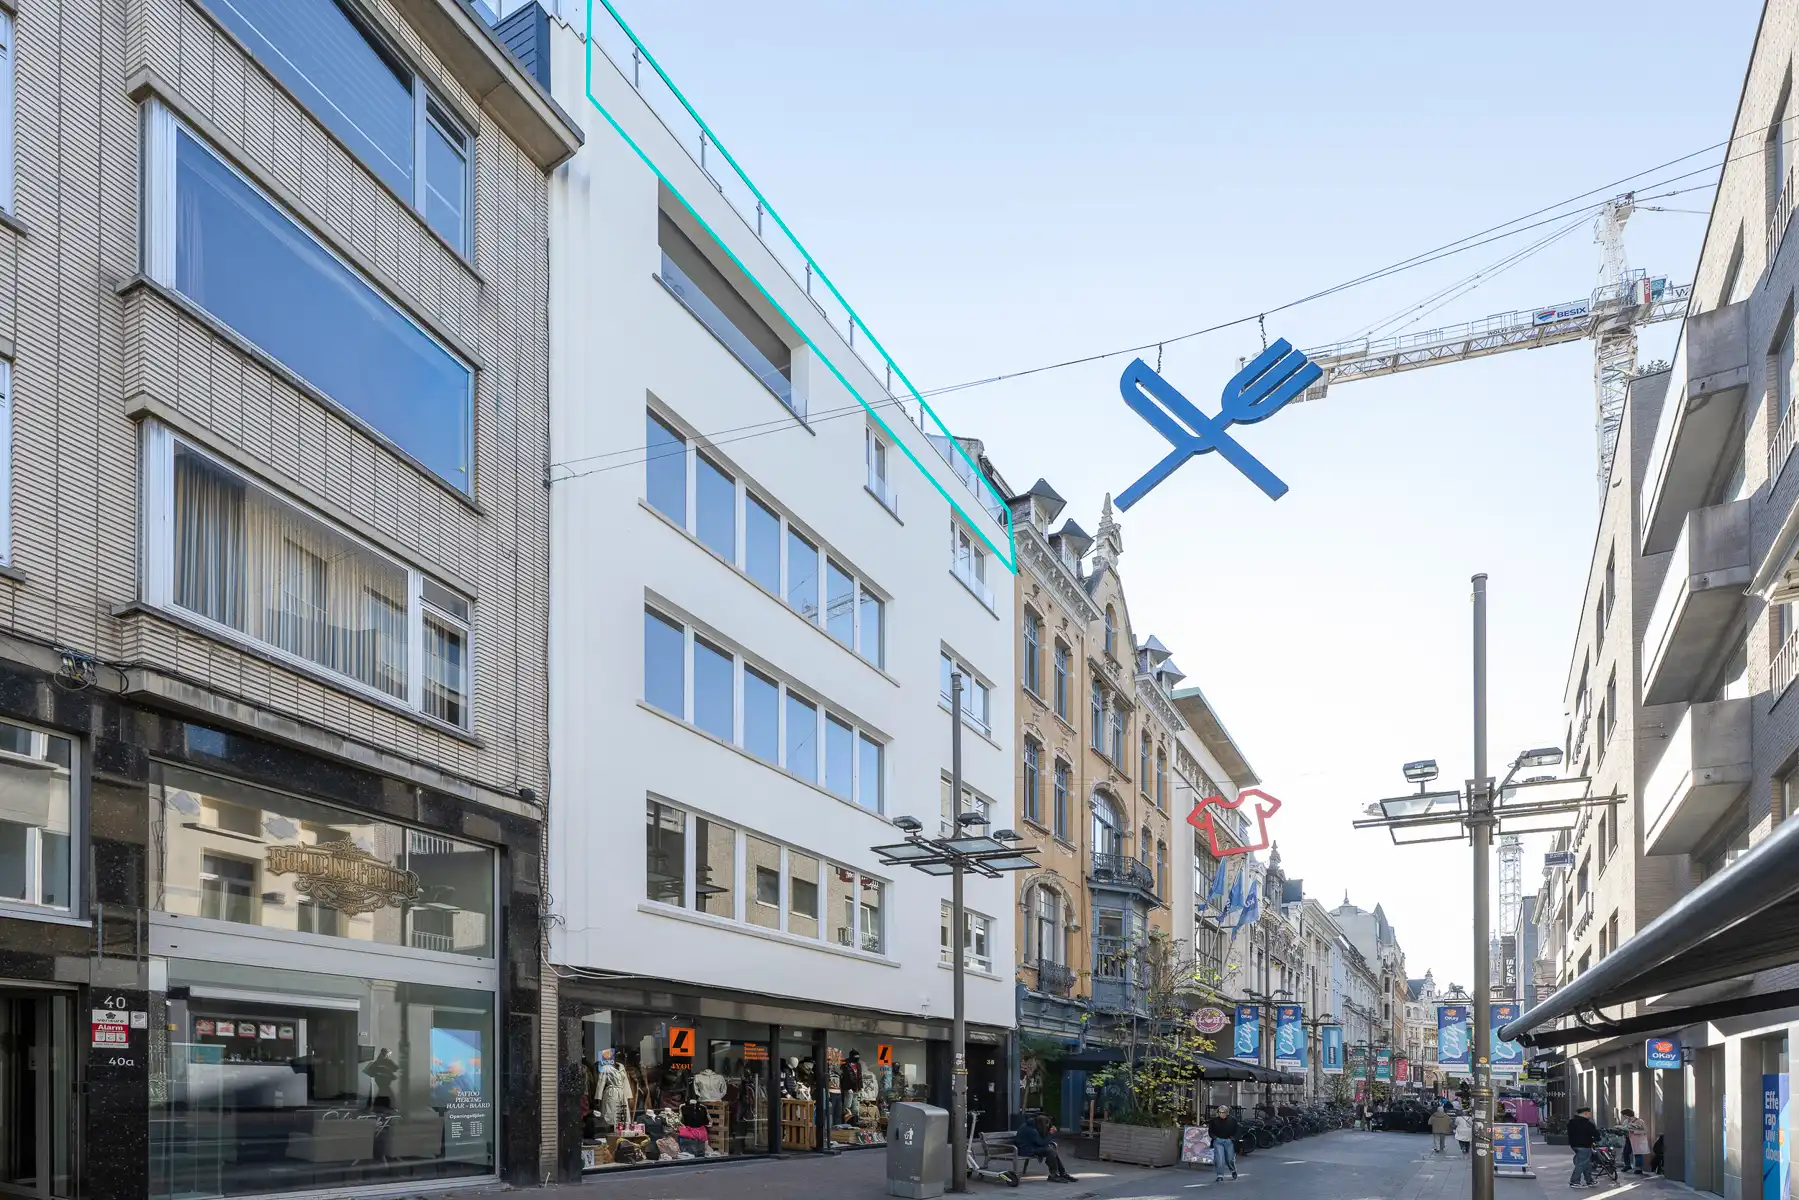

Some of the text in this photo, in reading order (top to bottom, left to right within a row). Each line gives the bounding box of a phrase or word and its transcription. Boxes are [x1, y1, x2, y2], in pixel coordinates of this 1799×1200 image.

[1557, 306, 1586, 318] BESIX
[104, 995, 126, 1009] 40
[1237, 1021, 1257, 1054] City
[1279, 1022, 1300, 1055] City
[1442, 1023, 1466, 1059] City
[108, 1057, 134, 1066] 40a
[1652, 1052, 1676, 1060] OKay
[1765, 1091, 1779, 1110] Effe
[1765, 1113, 1777, 1129] rap
